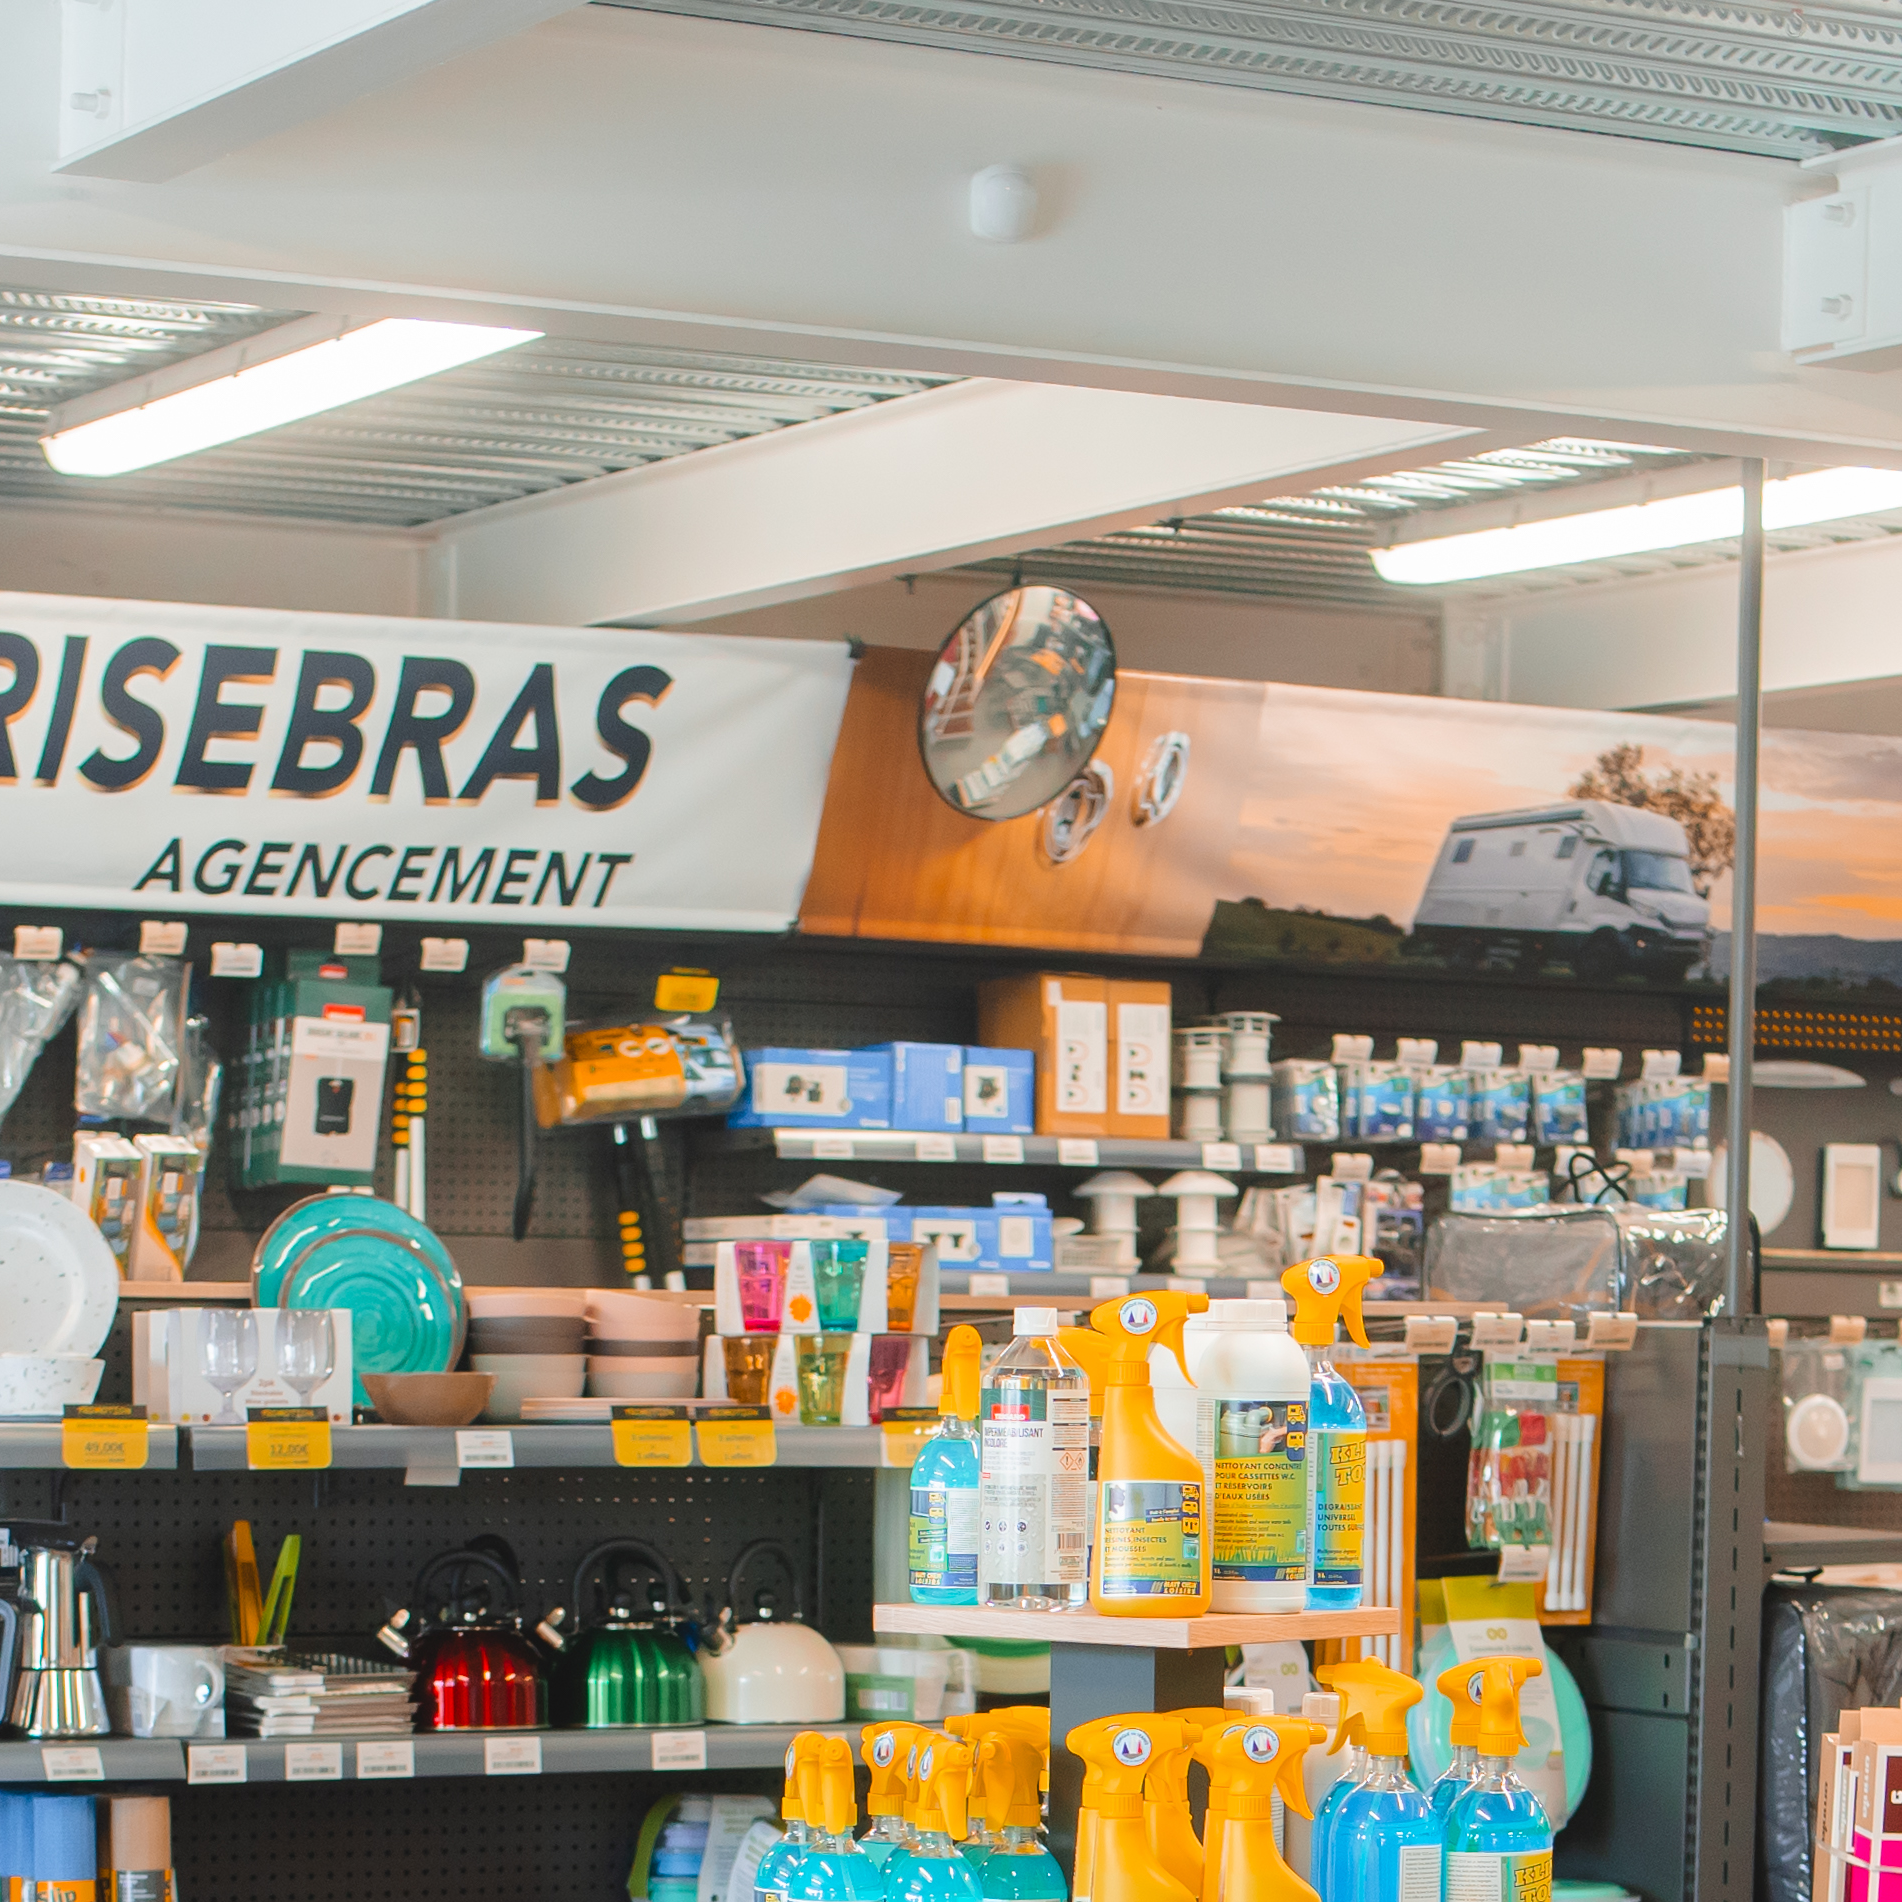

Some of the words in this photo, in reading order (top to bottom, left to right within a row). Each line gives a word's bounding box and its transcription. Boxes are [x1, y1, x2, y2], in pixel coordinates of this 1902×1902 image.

[133, 836, 632, 908] AGENCEMENT
[1214, 1462, 1261, 1470] NETTOYANT
[1214, 1472, 1236, 1480] POUR
[1237, 1472, 1280, 1480] CASSETTES
[1214, 1482, 1222, 1490] ET
